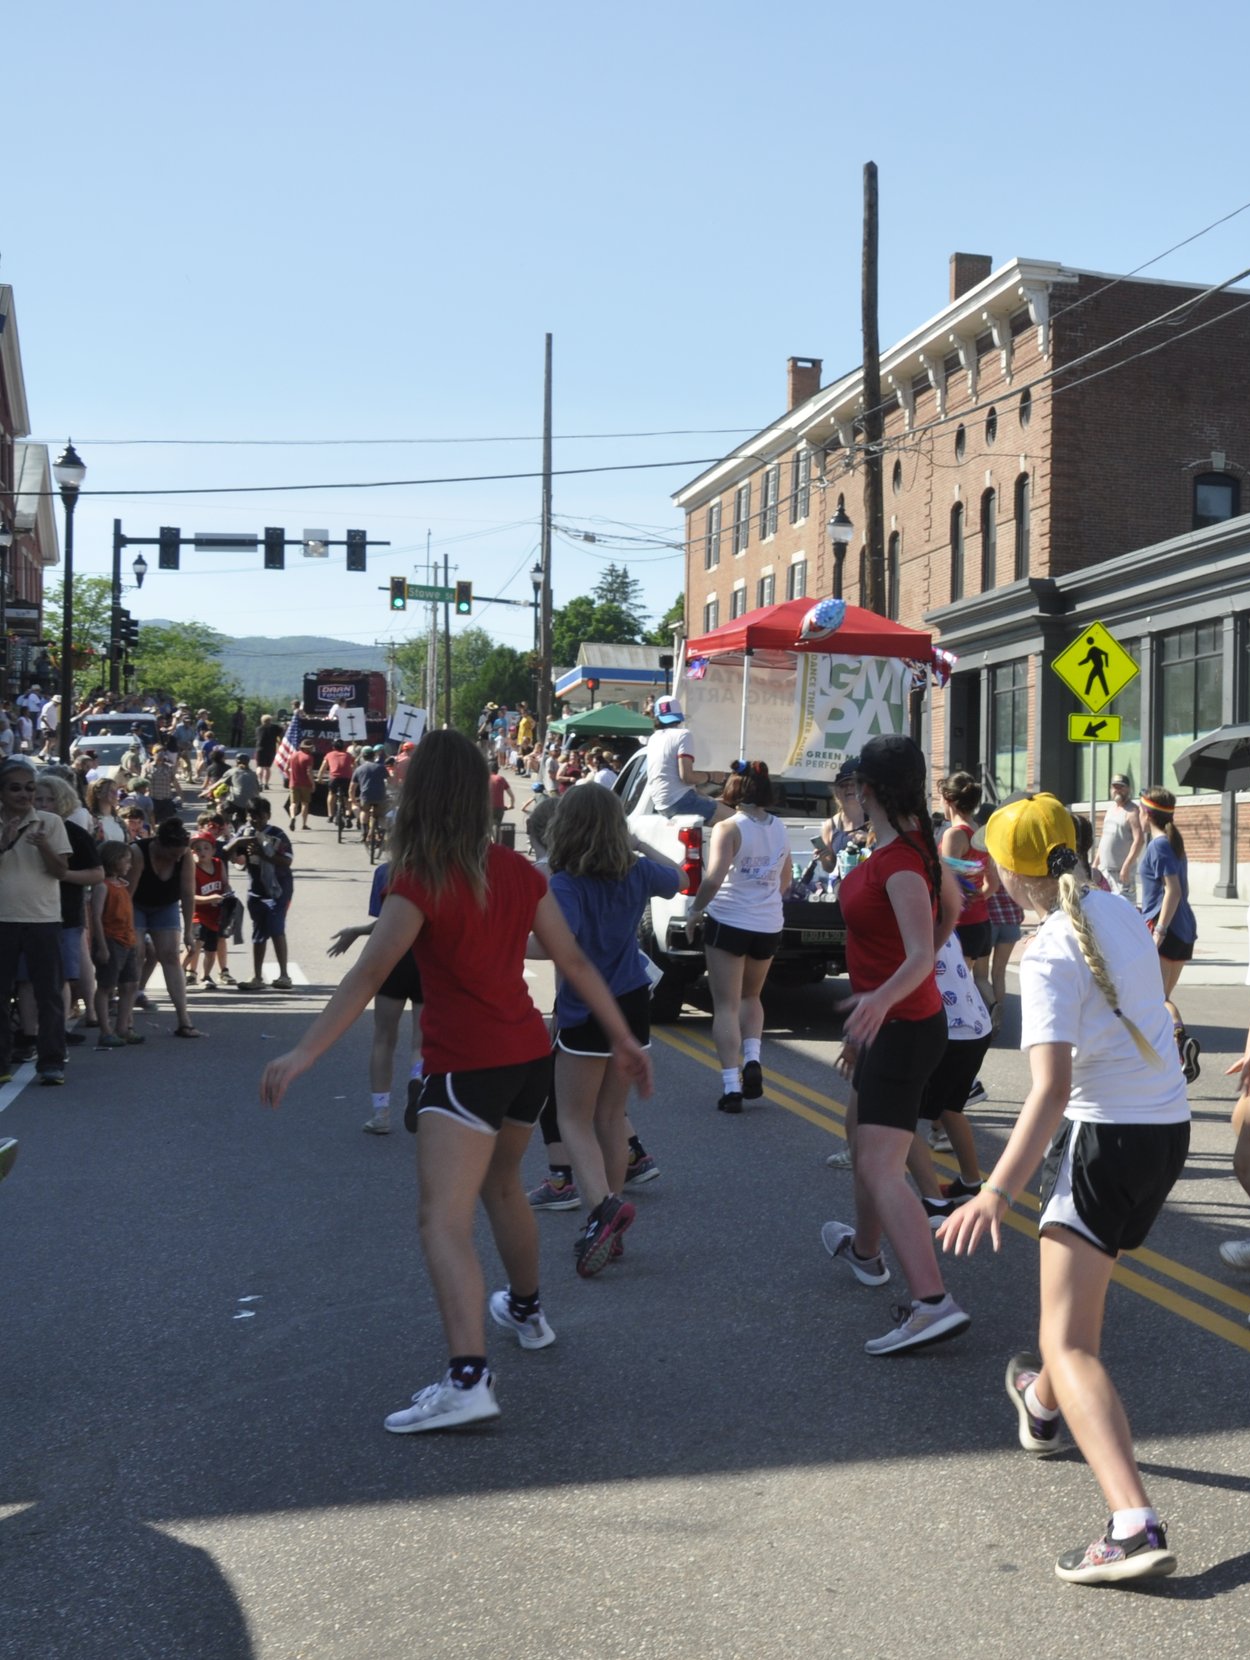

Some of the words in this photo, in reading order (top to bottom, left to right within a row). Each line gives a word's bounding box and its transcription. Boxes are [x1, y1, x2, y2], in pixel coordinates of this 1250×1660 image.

[408, 587, 440, 599] Stowe
[809, 654, 818, 687] DANCE
[321, 685, 352, 693] DARN
[805, 691, 816, 733] THEATRE
[806, 750, 841, 760] GREEN
[806, 760, 842, 770] PERFO
